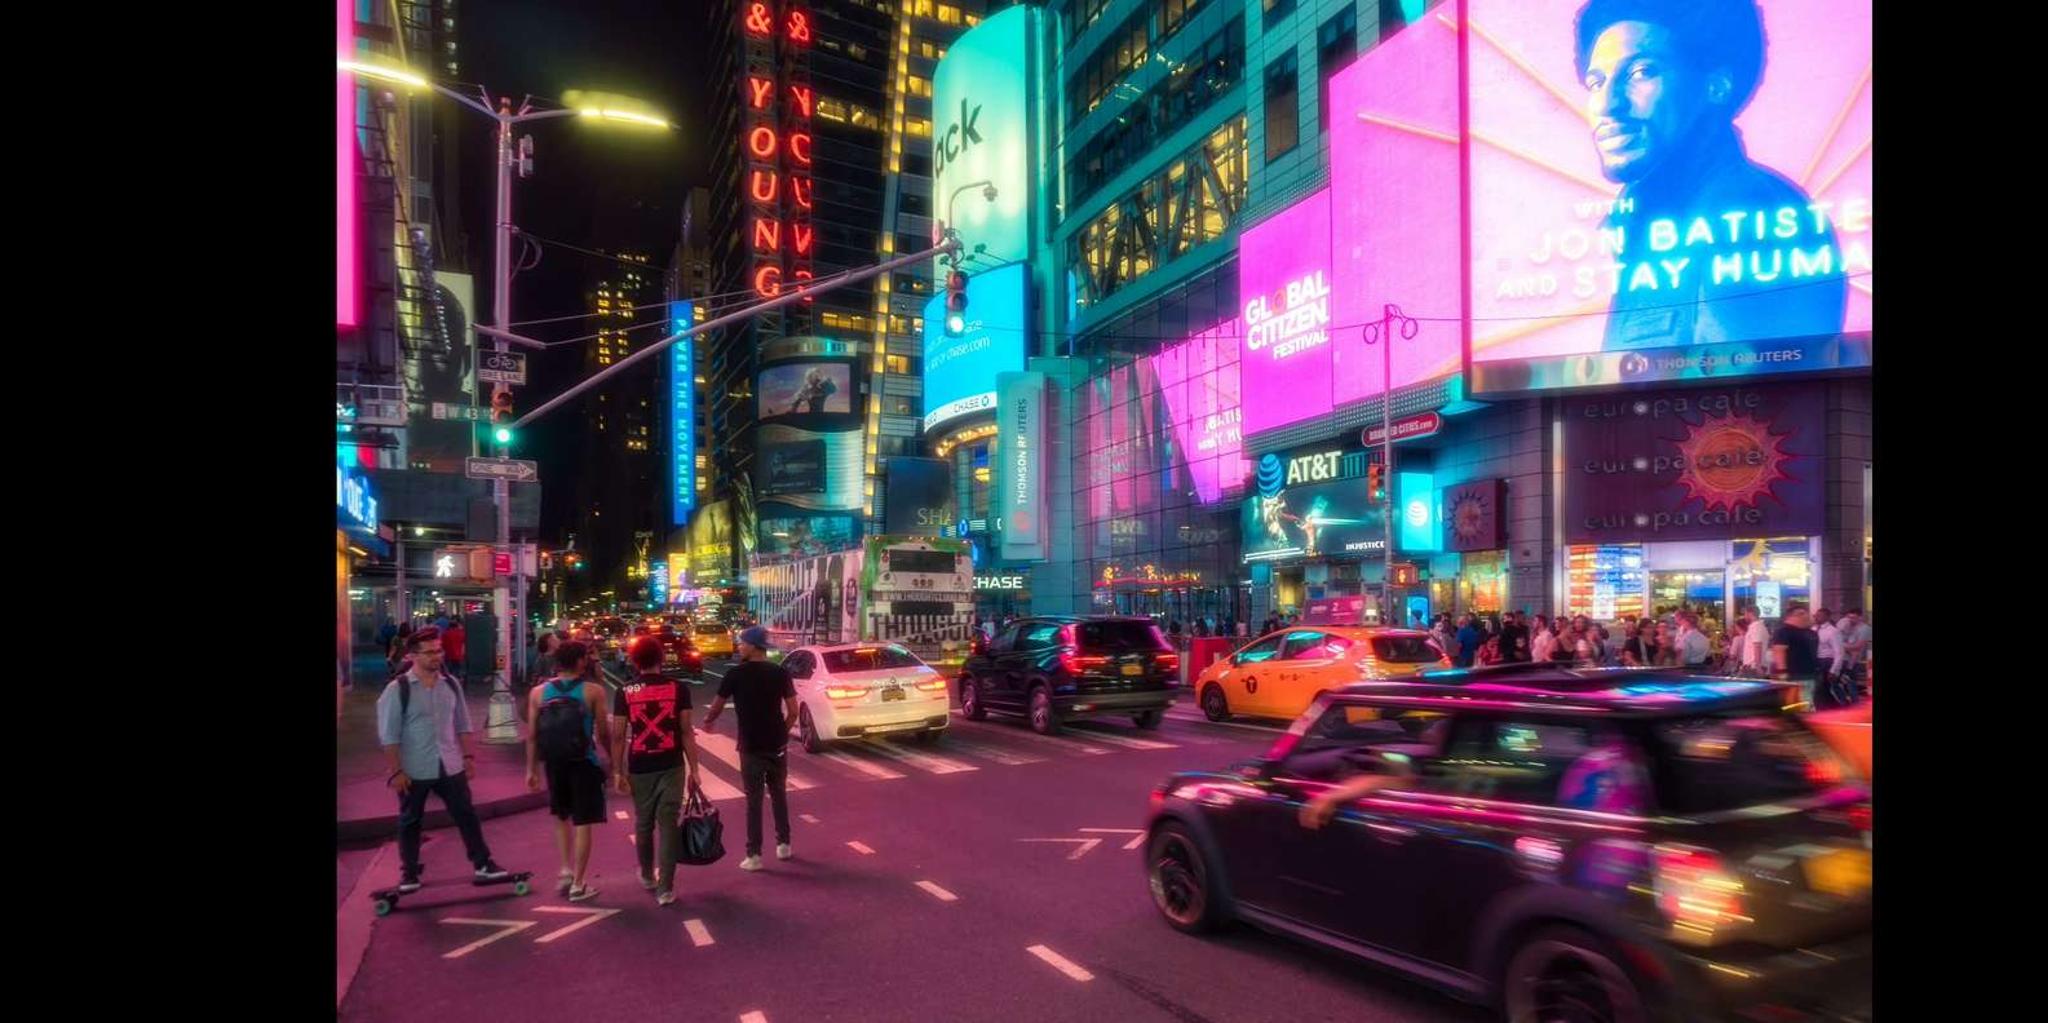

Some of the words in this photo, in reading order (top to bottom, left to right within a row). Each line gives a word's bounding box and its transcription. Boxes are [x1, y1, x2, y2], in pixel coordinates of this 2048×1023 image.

[746, 3, 770, 33] &
[750, 78, 780, 297] YOUNG
[1575, 197, 1634, 219] WITH
[1529, 226, 1624, 264] JON
[1650, 201, 1872, 253] BATISTE
[1497, 272, 1558, 298] AND
[1572, 258, 1690, 298] STAY
[1245, 269, 1330, 325] GLOBAL
[1273, 329, 1329, 359] FESTIVAL
[1655, 356, 1728, 370] THOMSON
[1732, 350, 1802, 364] REUTERS
[676, 382, 688, 409] THE
[1699, 389, 1761, 412] cafe
[677, 419, 690, 504] MOVEMENT
[1287, 451, 1343, 486] AT&T
[1699, 446, 1763, 470] cafe
[1016, 450, 1028, 505] THOMSON
[1699, 504, 1762, 526] cafe
